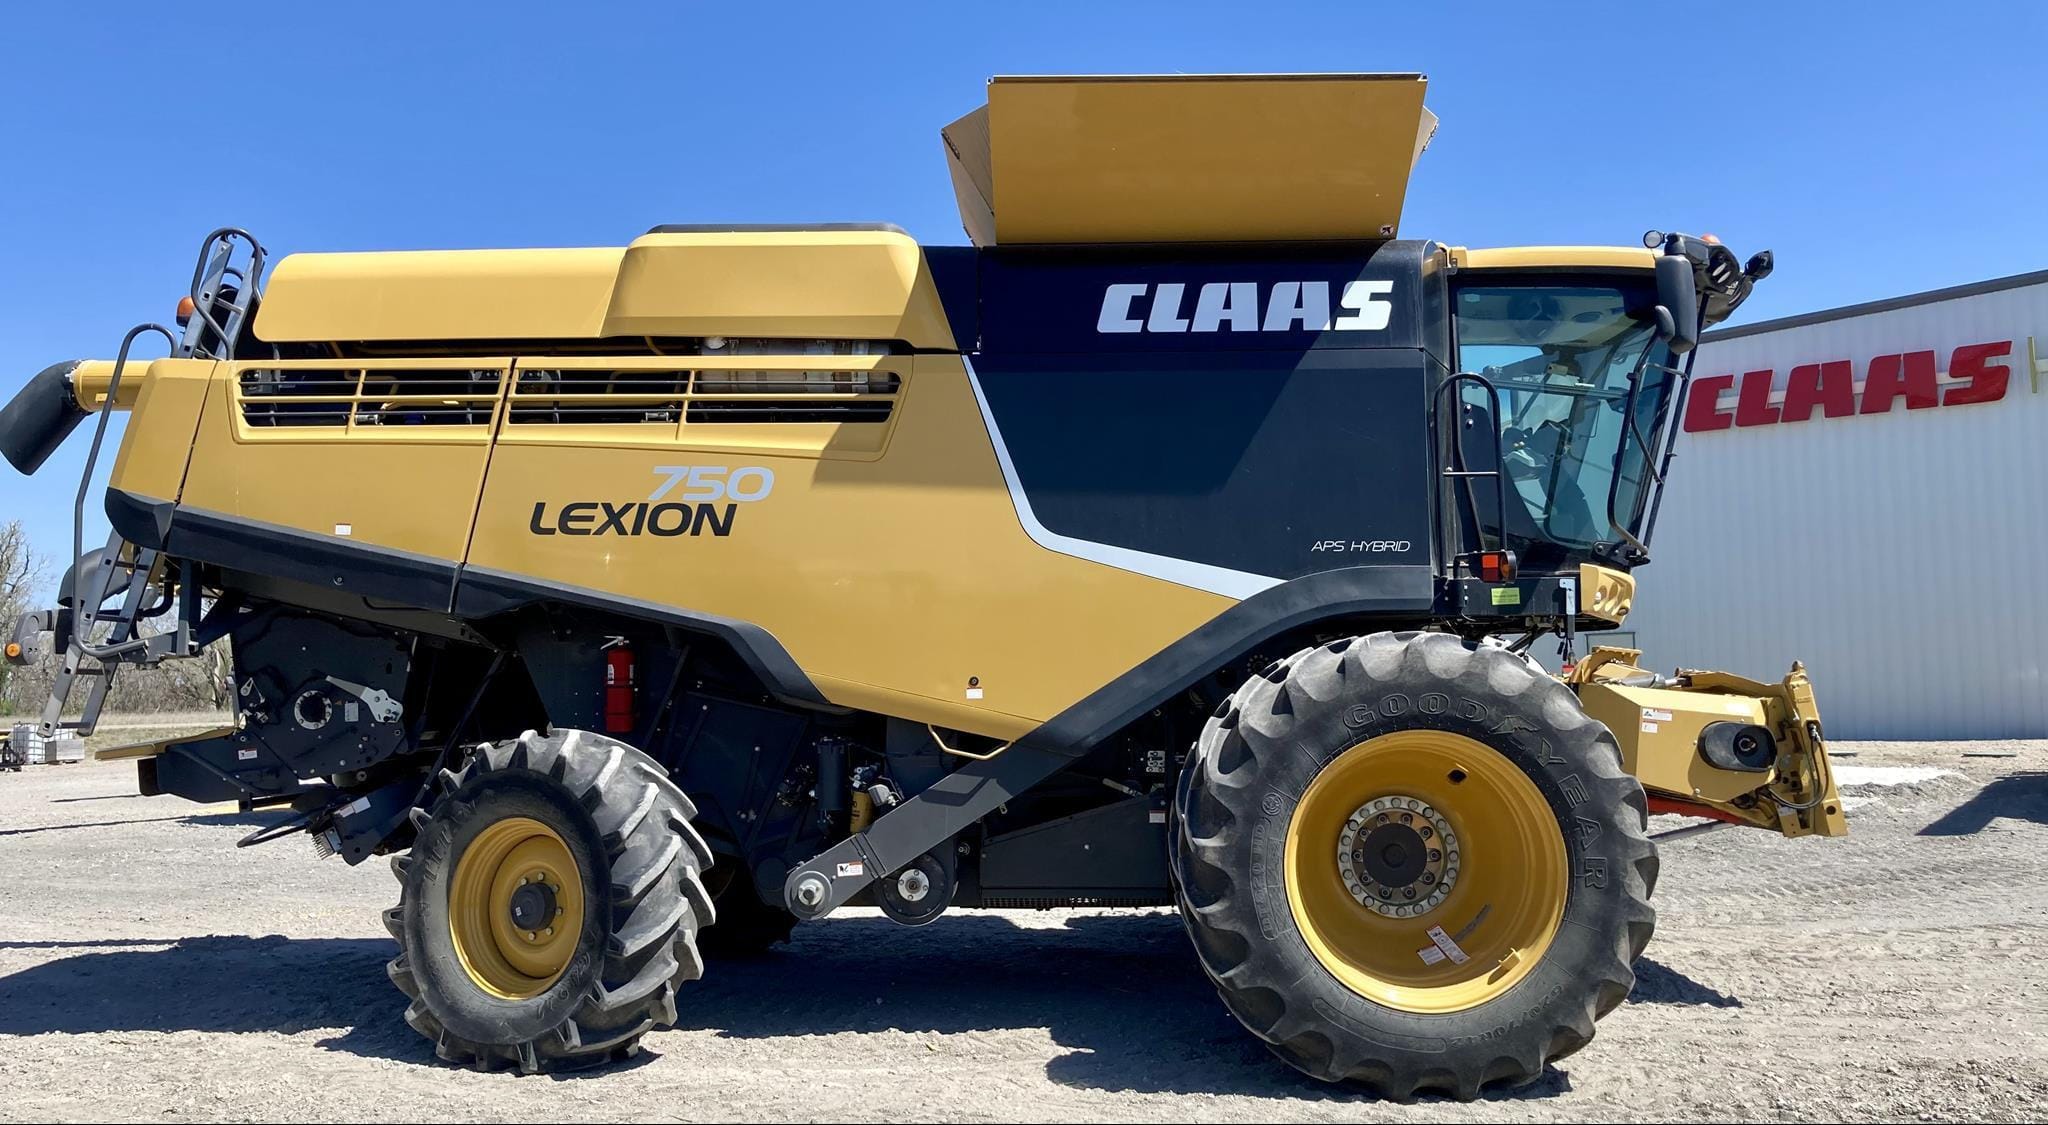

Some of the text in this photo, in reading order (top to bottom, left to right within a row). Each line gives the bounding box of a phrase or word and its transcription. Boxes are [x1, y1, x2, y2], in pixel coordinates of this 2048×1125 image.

[1096, 280, 1395, 334] CLAAS
[1683, 340, 2013, 433] CLAAS
[647, 465, 776, 502] 750
[529, 501, 738, 537] LEXION
[1310, 540, 1411, 553] APS HYBRID
